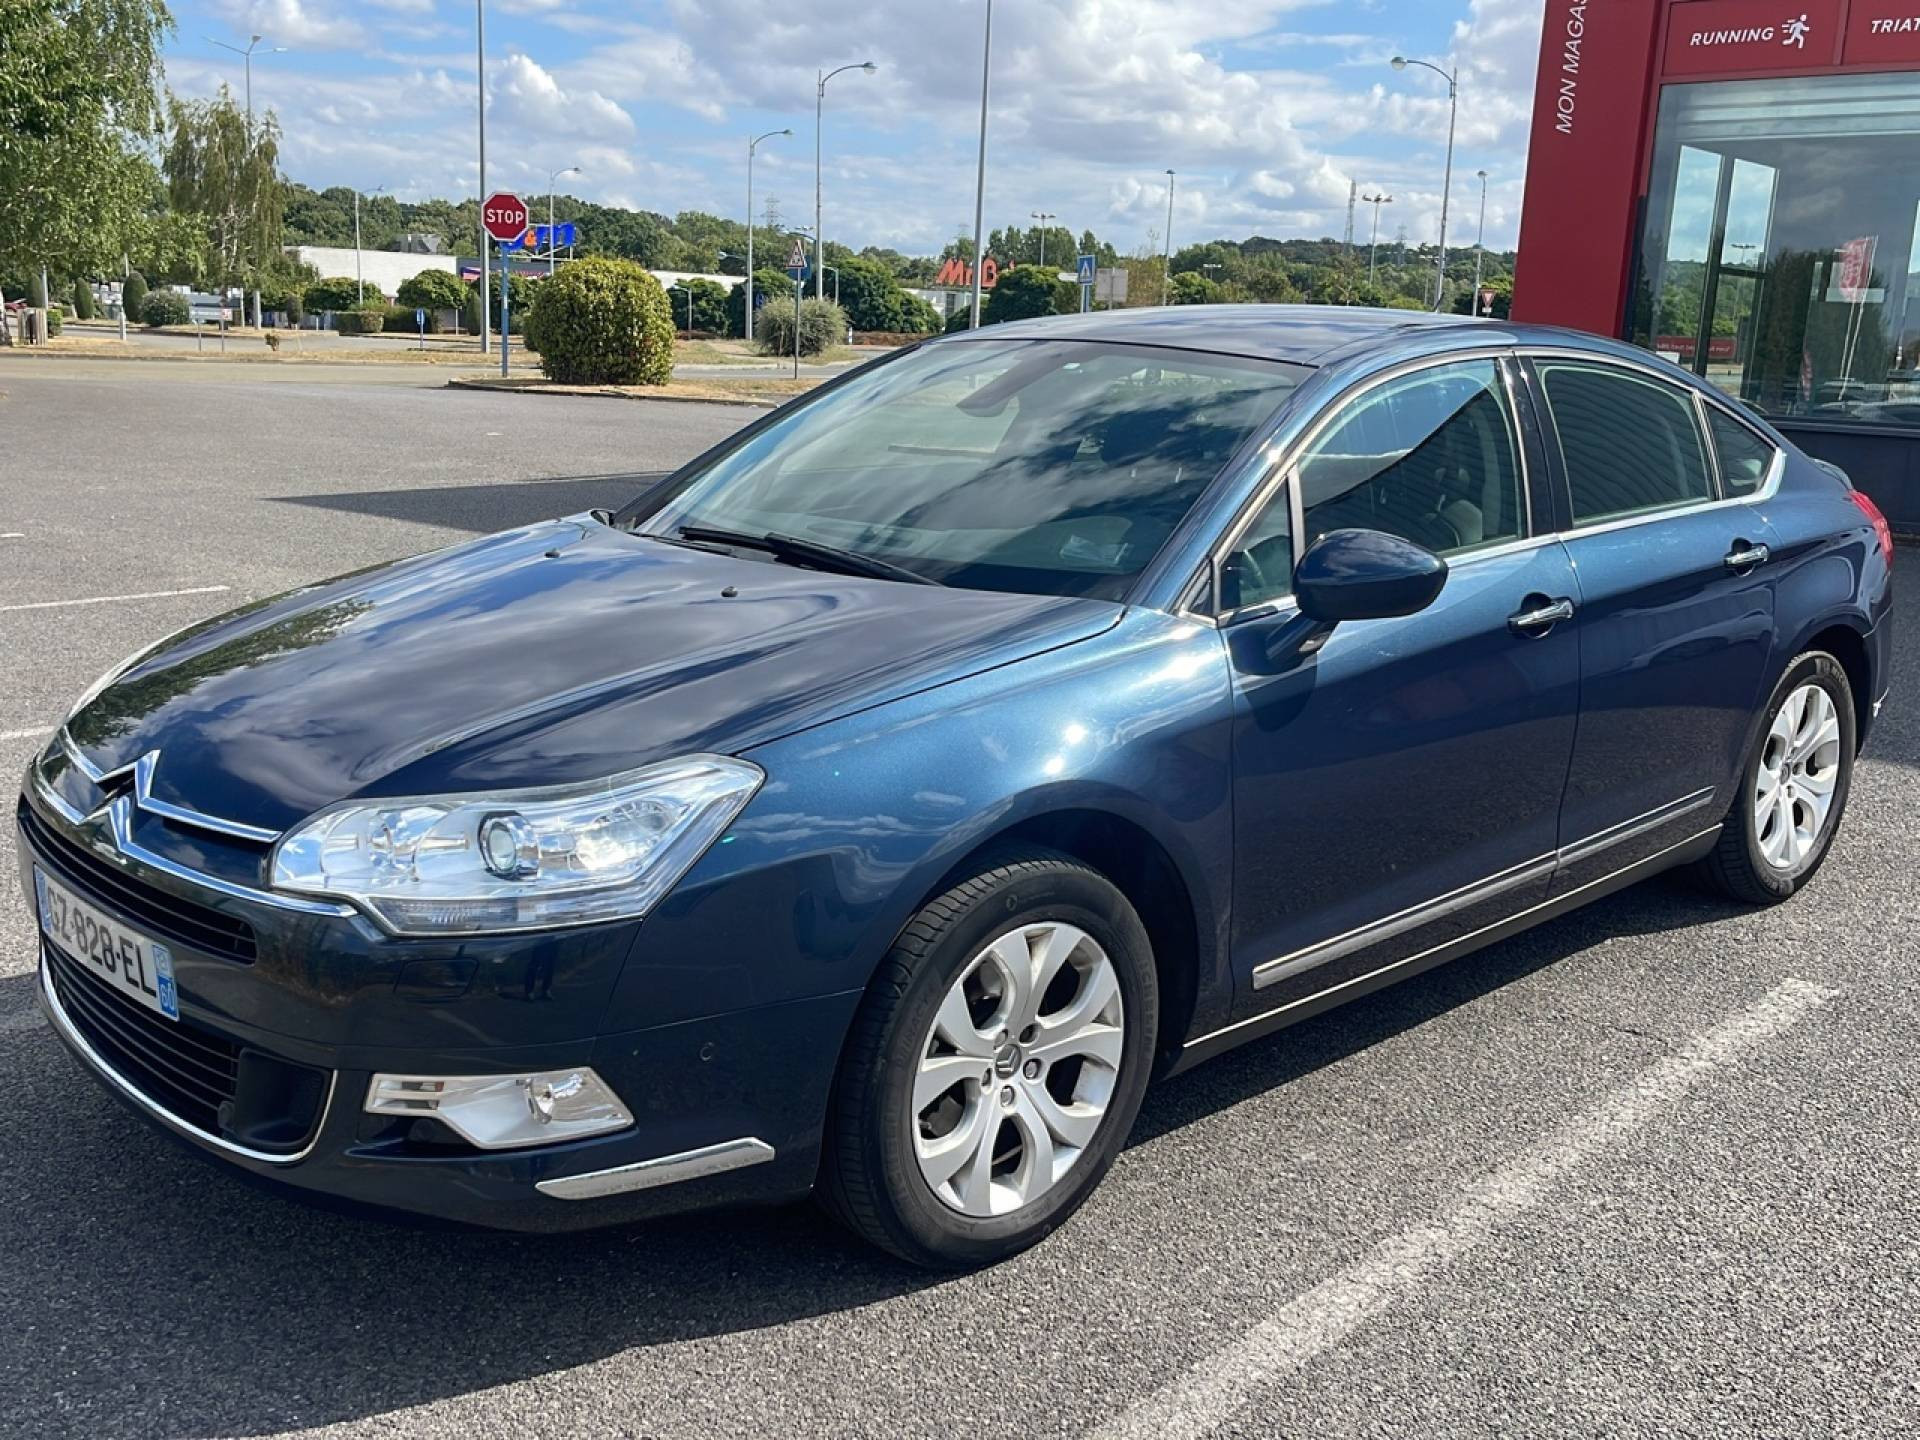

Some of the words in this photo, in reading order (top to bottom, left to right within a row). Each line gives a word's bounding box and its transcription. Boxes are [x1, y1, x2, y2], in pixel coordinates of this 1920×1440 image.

[1690, 26, 1774, 46] RUNNING
[1555, 78, 1577, 134] MON
[486, 208, 524, 225] STOP
